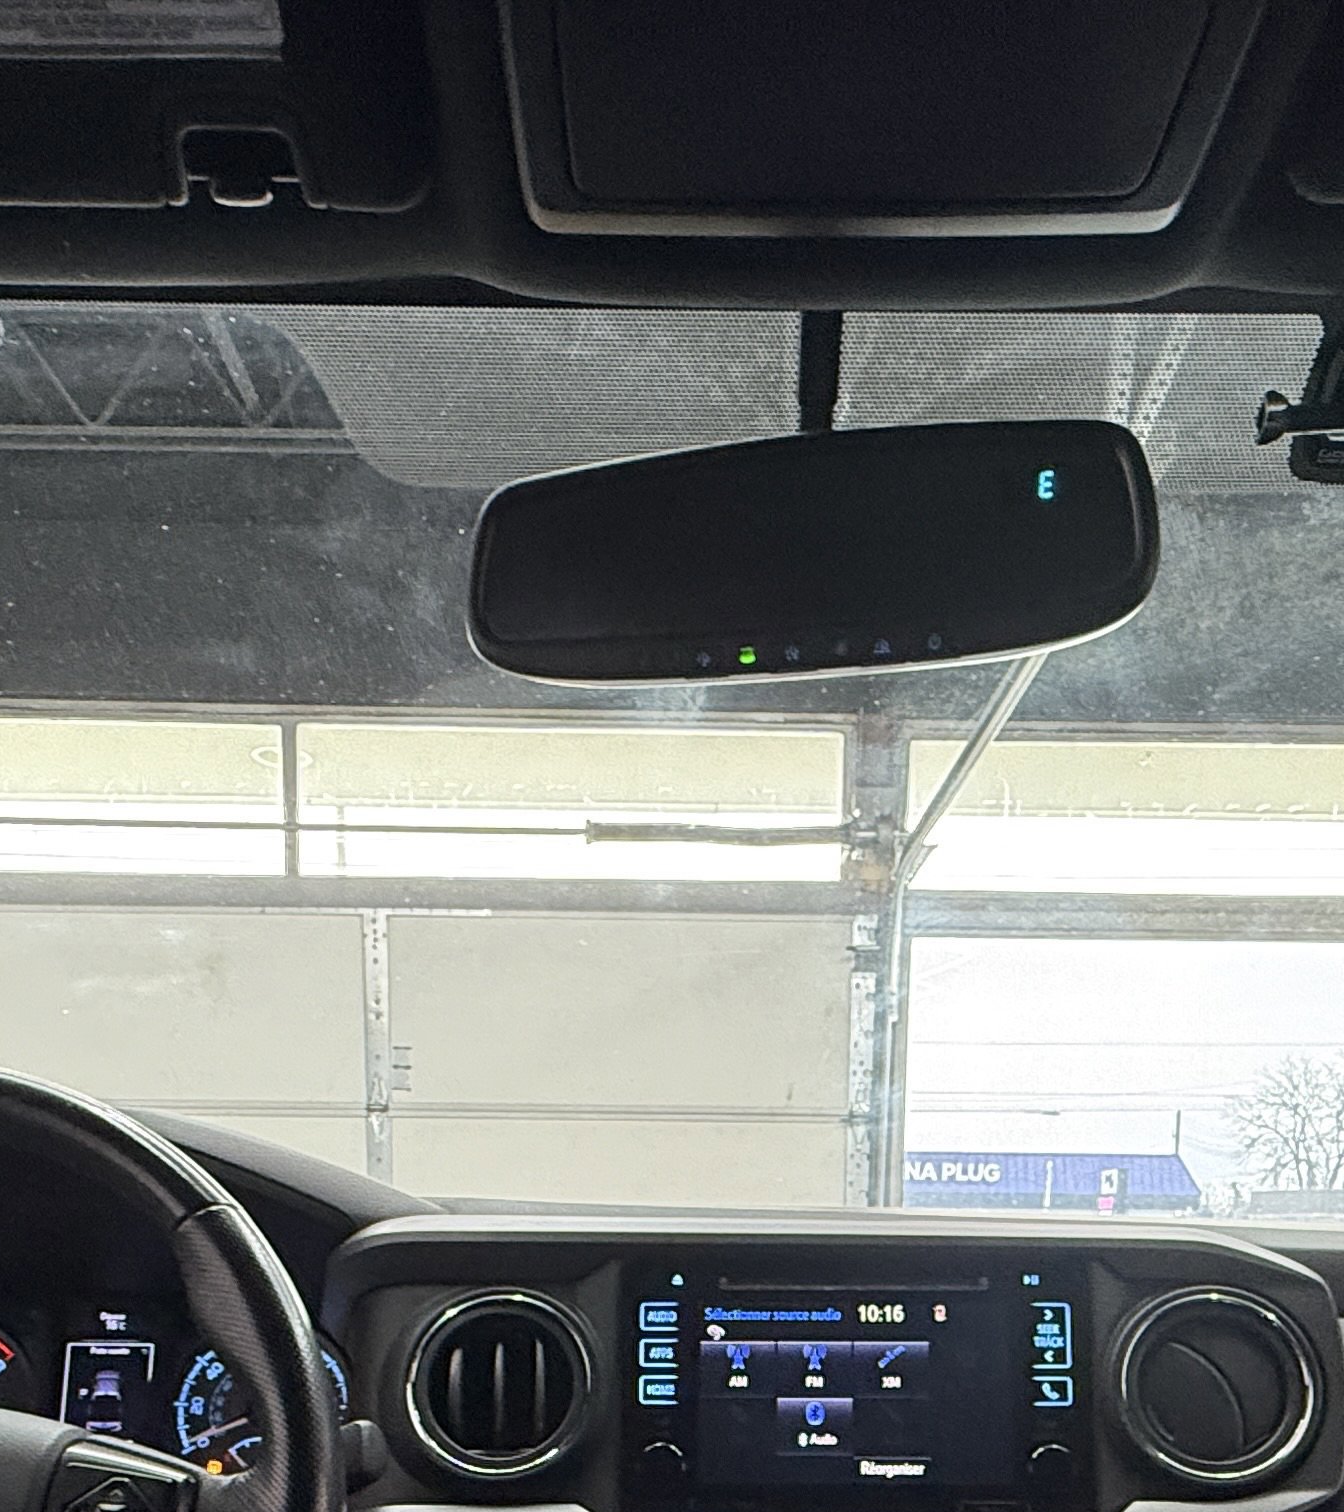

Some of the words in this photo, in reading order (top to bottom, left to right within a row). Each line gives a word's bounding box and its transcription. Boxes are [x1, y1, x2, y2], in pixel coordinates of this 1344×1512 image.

[1038, 470, 1054, 498] E
[904, 1161, 937, 1181] NA
[941, 1162, 1001, 1182] PLUG
[704, 1306, 772, 1321] Sélectionner
[773, 1309, 809, 1321] source
[811, 1307, 842, 1321] audio
[857, 1304, 905, 1323] 10:16
[728, 1375, 749, 1388] AM
[805, 1375, 824, 1388] FM
[880, 1375, 902, 1389] XM
[190, 1396, 205, 1415] 20
[197, 1436, 210, 1448] 0
[809, 1433, 839, 1446] Audio
[860, 1460, 926, 1479] Réorganiser
